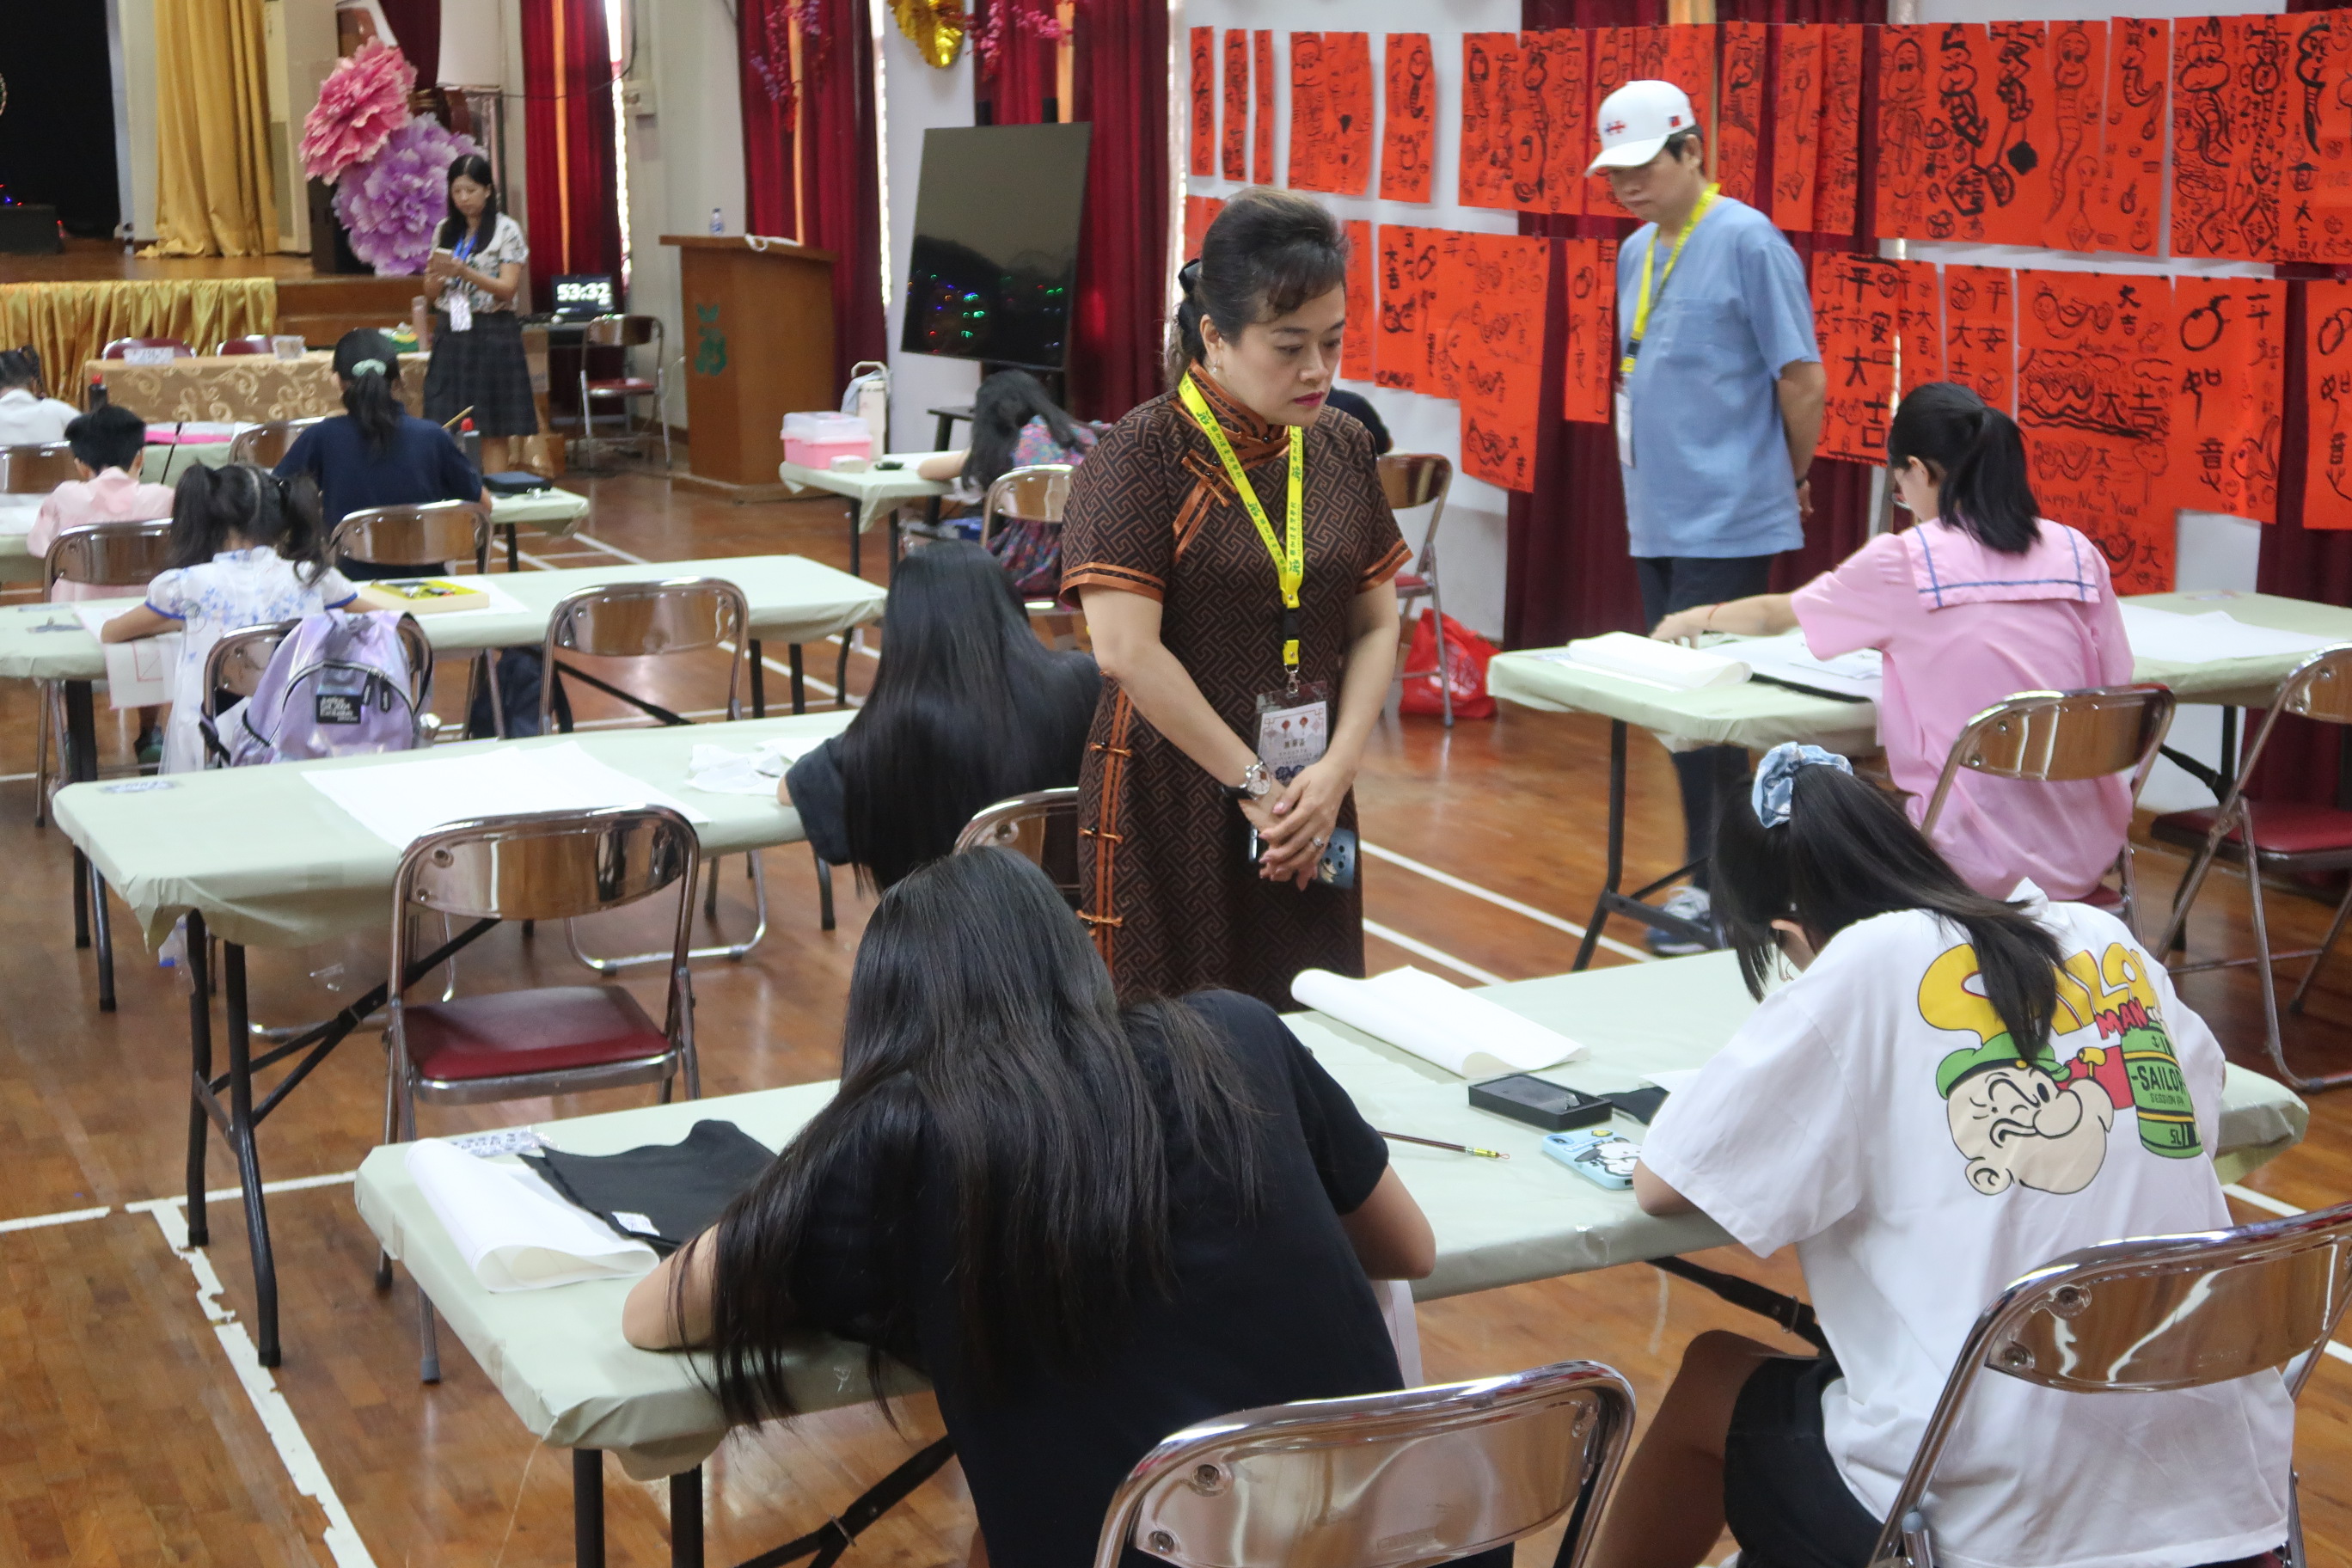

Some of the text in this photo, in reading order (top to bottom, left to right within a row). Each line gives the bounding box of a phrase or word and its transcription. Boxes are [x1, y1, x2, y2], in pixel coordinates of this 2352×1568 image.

[556, 282, 611, 303] 53:32
[2095, 996, 2150, 1040] MAN
[2150, 1093, 2177, 1106] SESSION
